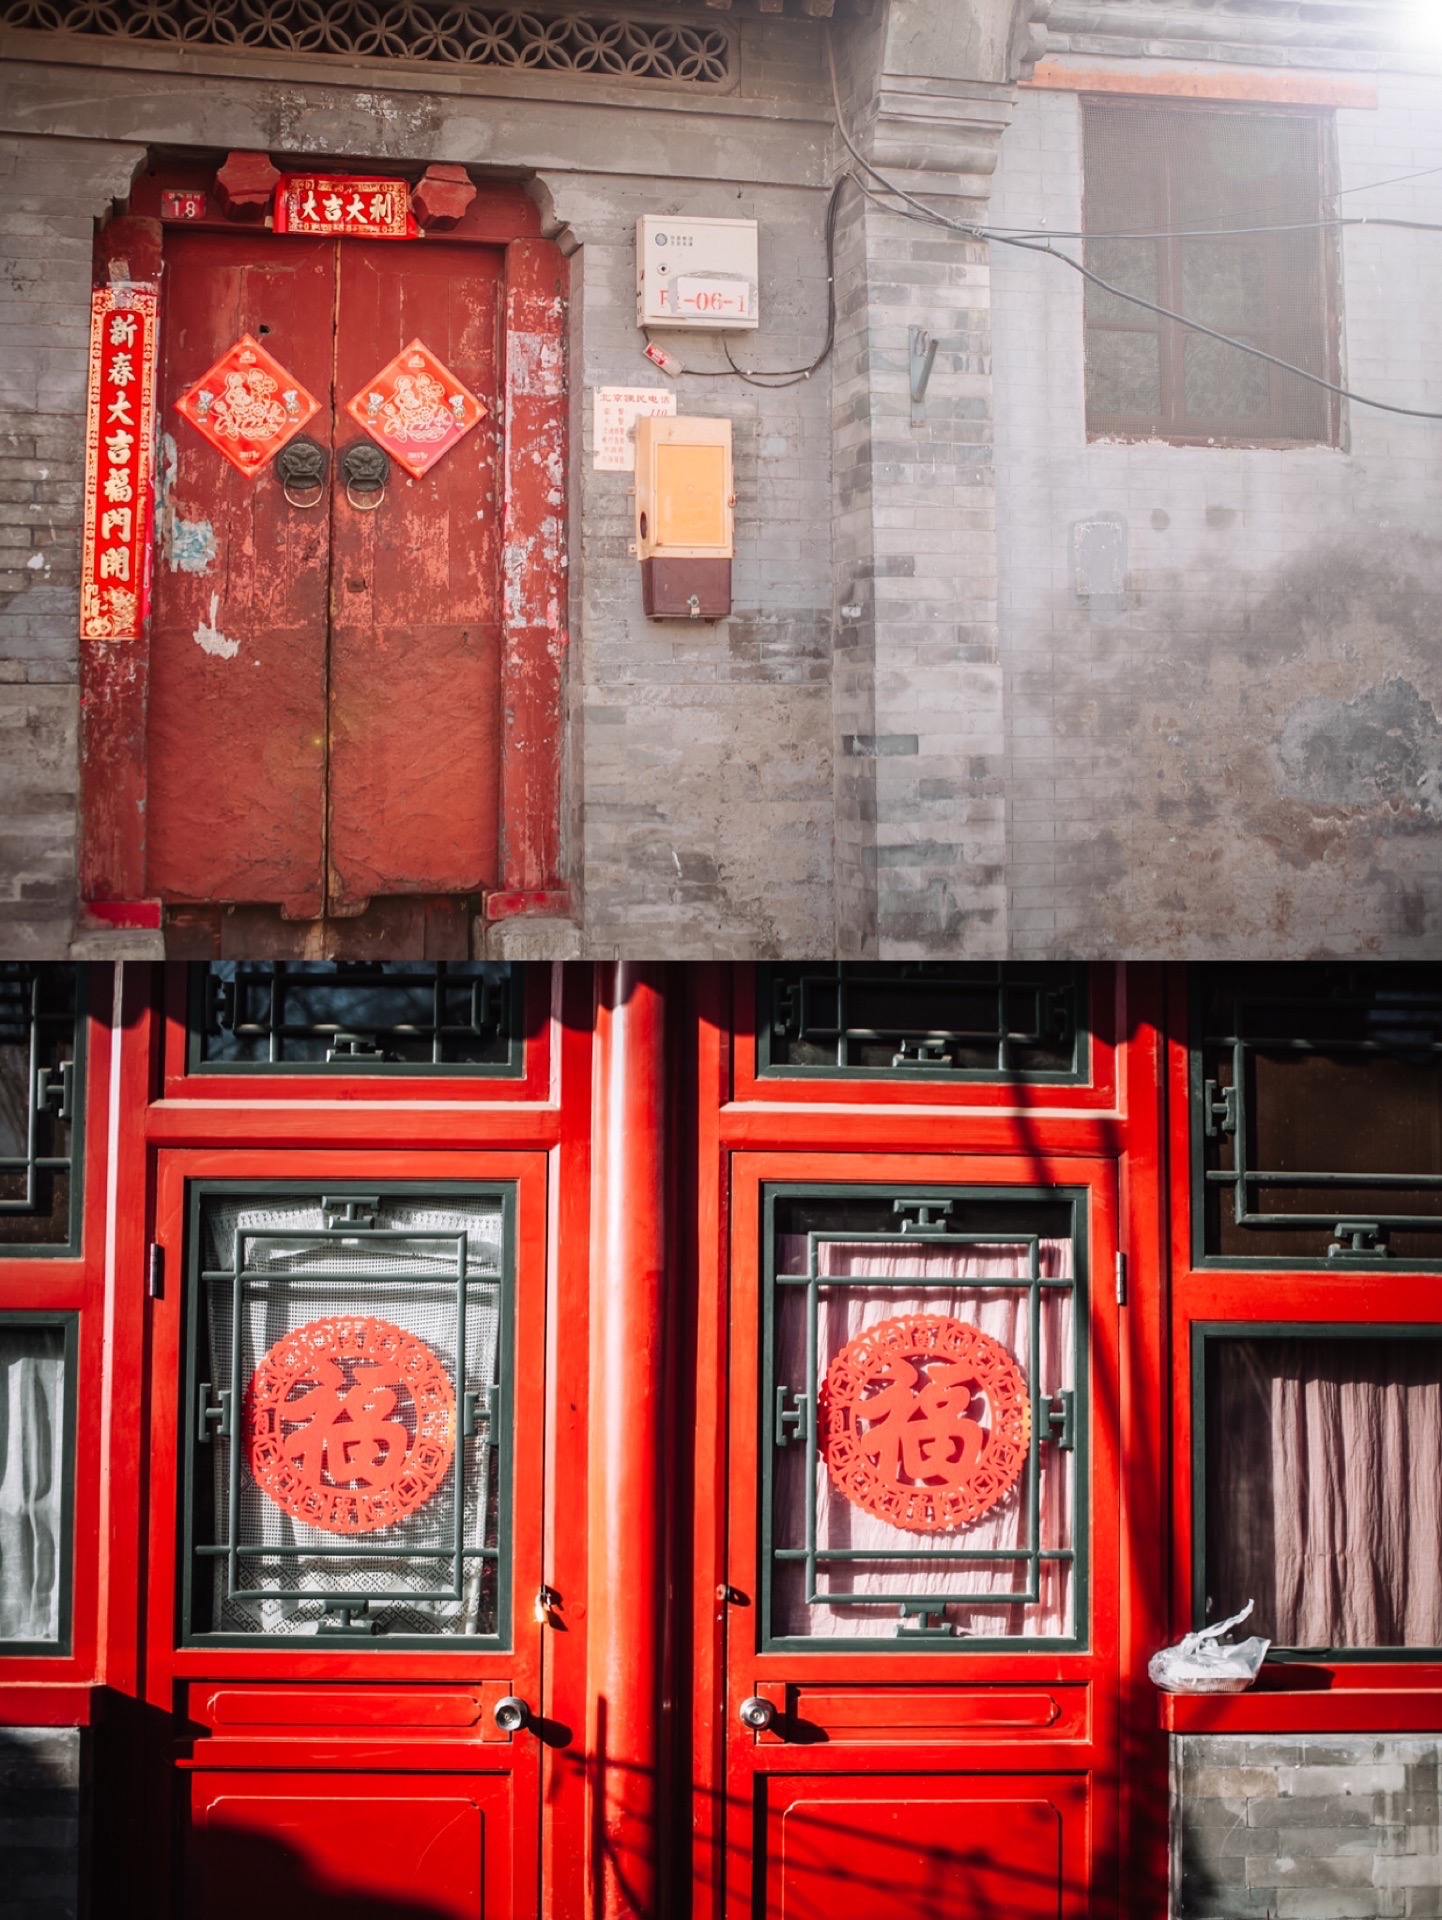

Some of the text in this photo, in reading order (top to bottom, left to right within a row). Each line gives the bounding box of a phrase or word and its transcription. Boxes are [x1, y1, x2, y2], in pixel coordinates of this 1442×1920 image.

[172, 200, 196, 219] 18
[300, 190, 394, 224] 大吉大利
[281, 1357, 408, 1485] 福
[851, 1356, 983, 1484] 福
